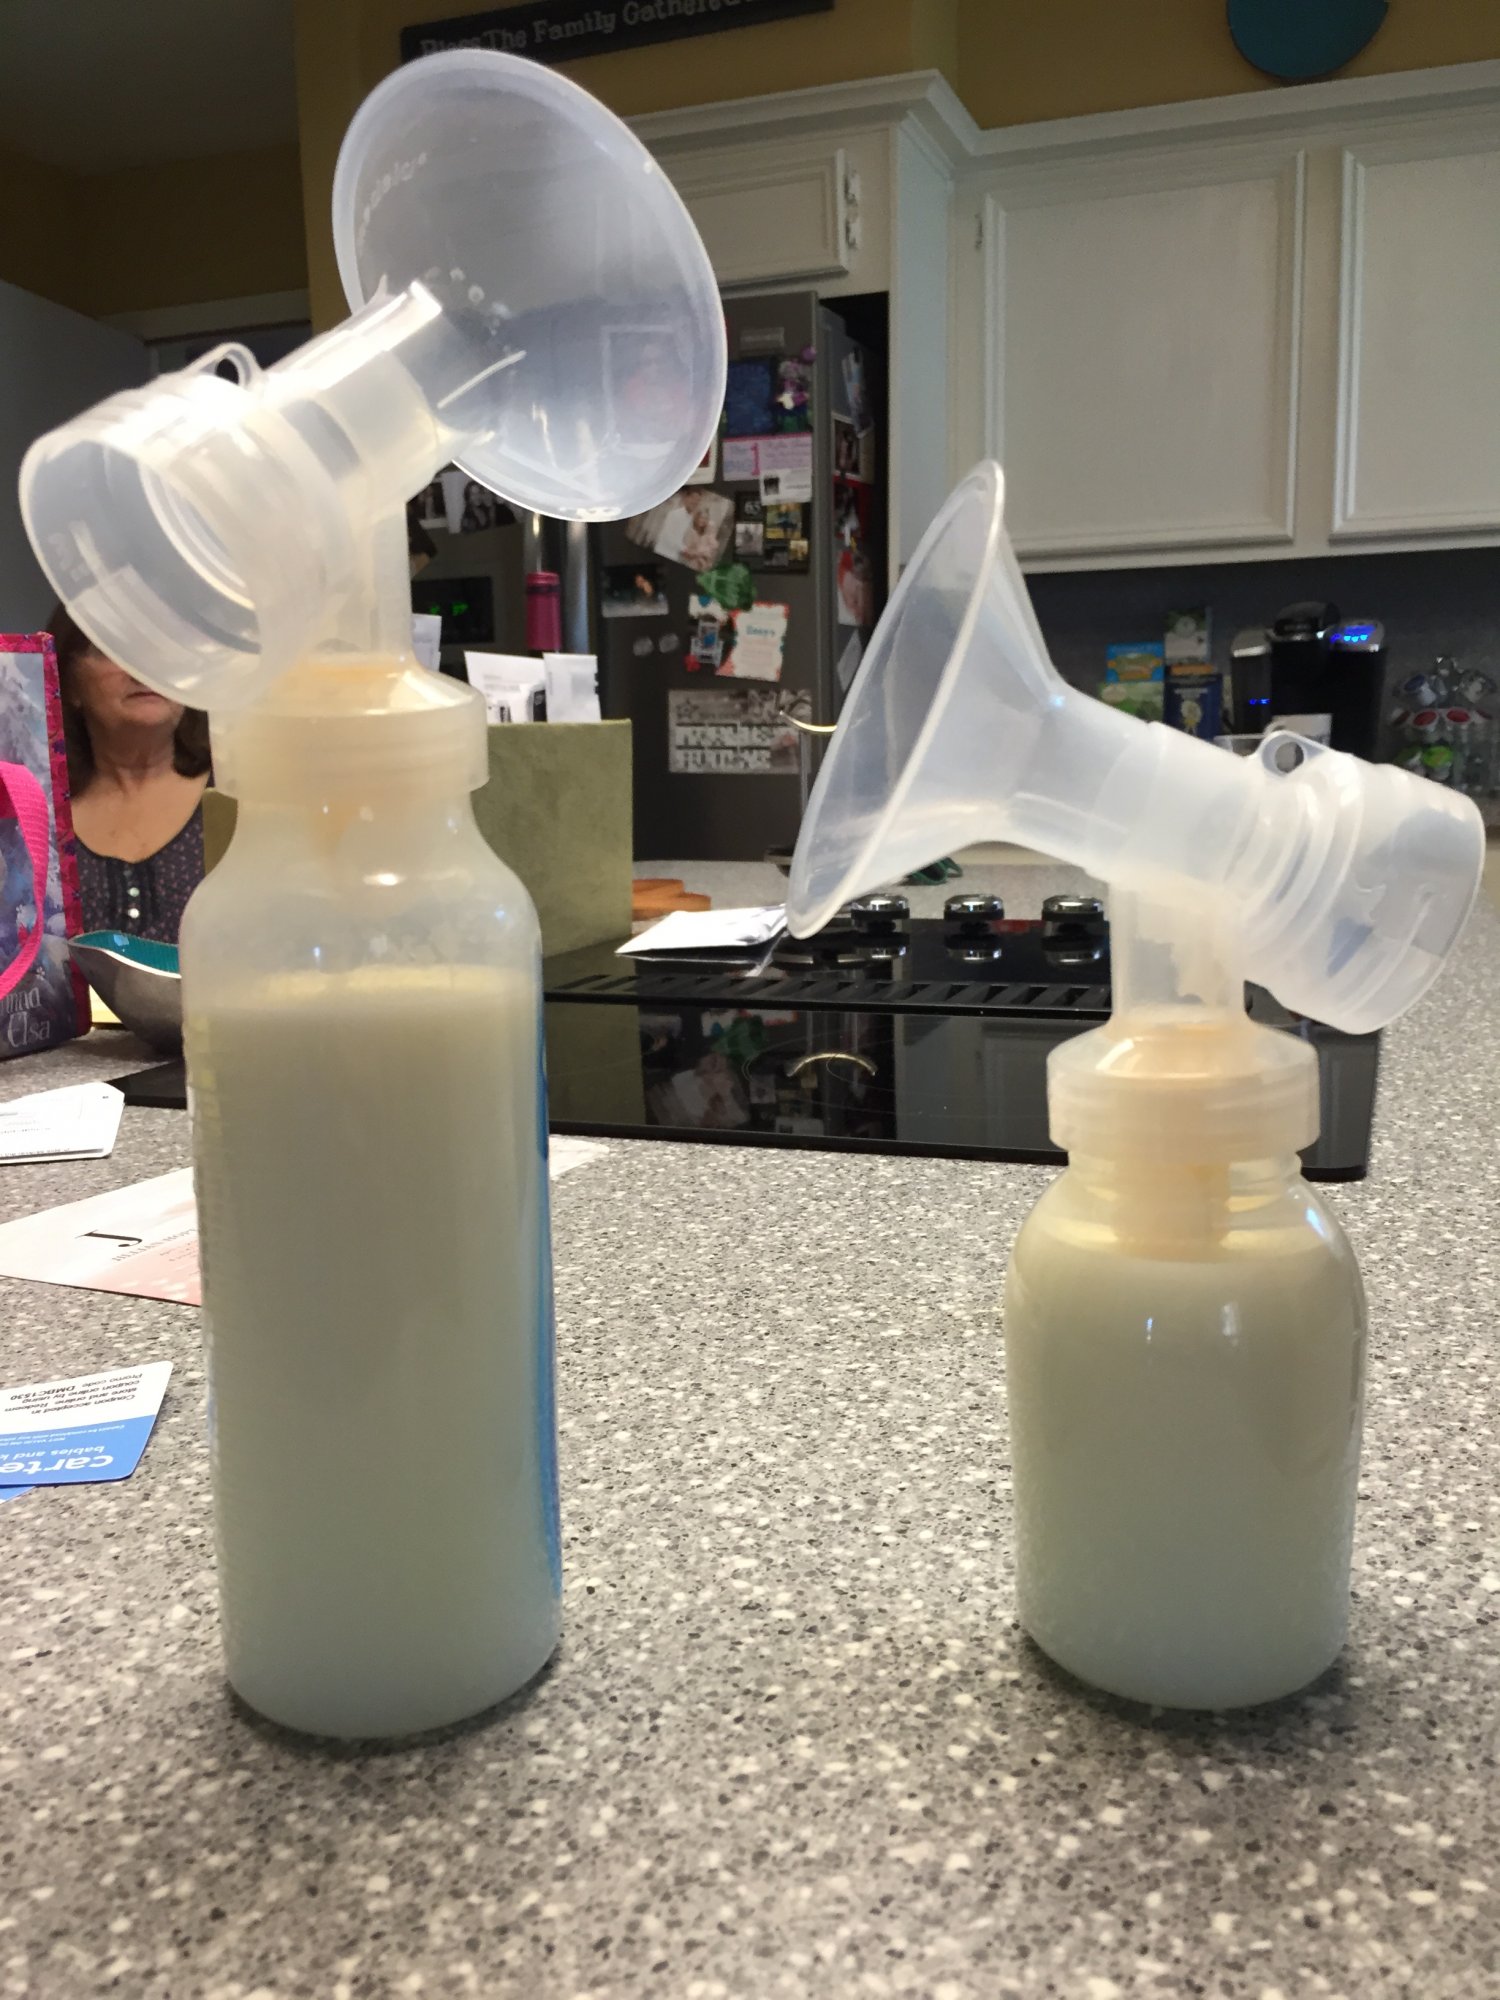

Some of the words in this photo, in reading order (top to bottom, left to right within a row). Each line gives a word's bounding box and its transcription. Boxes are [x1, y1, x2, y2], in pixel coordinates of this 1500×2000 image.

[533, 10, 617, 43] Family
[102, 1380, 140, 1390] coupon
[68, 1387, 99, 1396] online
[89, 1392, 109, 1400] and
[94, 1394, 135, 1405] Coupon
[42, 1402, 92, 1413] accepted
[15, 1450, 46, 1460] and
[50, 1444, 105, 1456] babies
